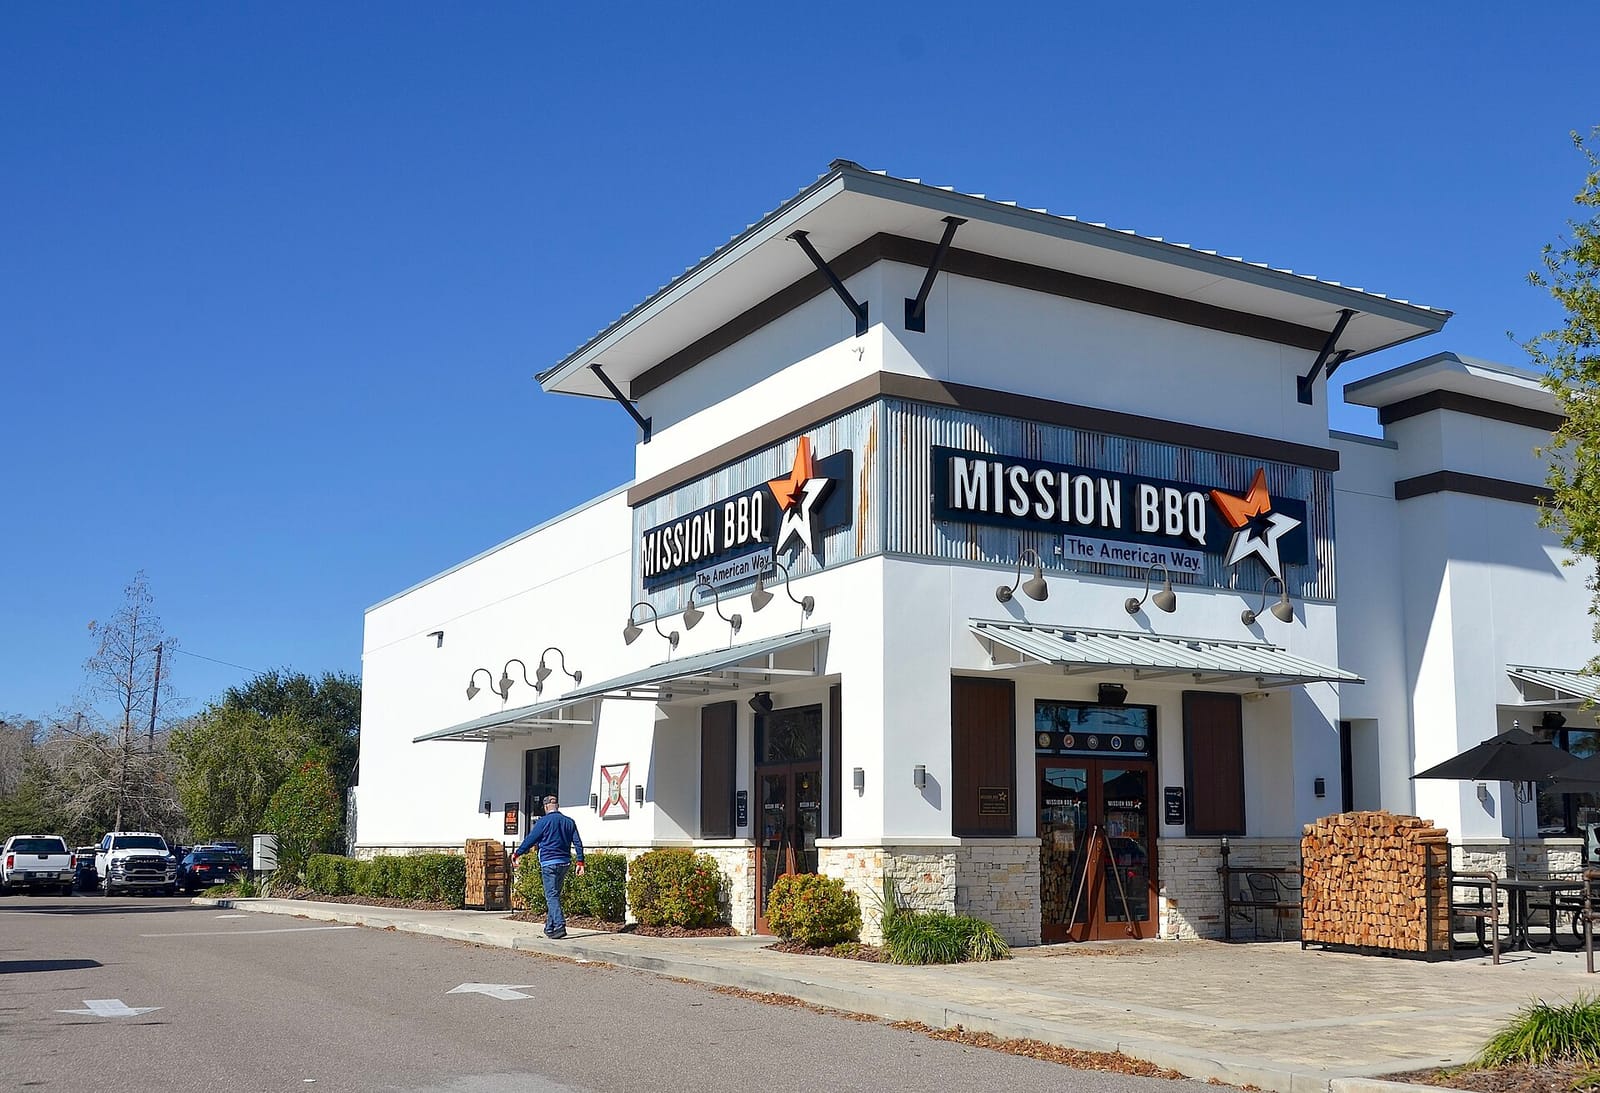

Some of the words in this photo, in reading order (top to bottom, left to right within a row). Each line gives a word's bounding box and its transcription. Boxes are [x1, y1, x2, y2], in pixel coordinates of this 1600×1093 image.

[951, 456, 1121, 529] MISSION
[1138, 483, 1206, 546] BBQ
[641, 508, 715, 577] MISSION
[723, 490, 763, 549] BBQ
[1067, 538, 1094, 556] The
[1100, 543, 1166, 565] American
[697, 572, 711, 585] The
[712, 562, 750, 583] American
